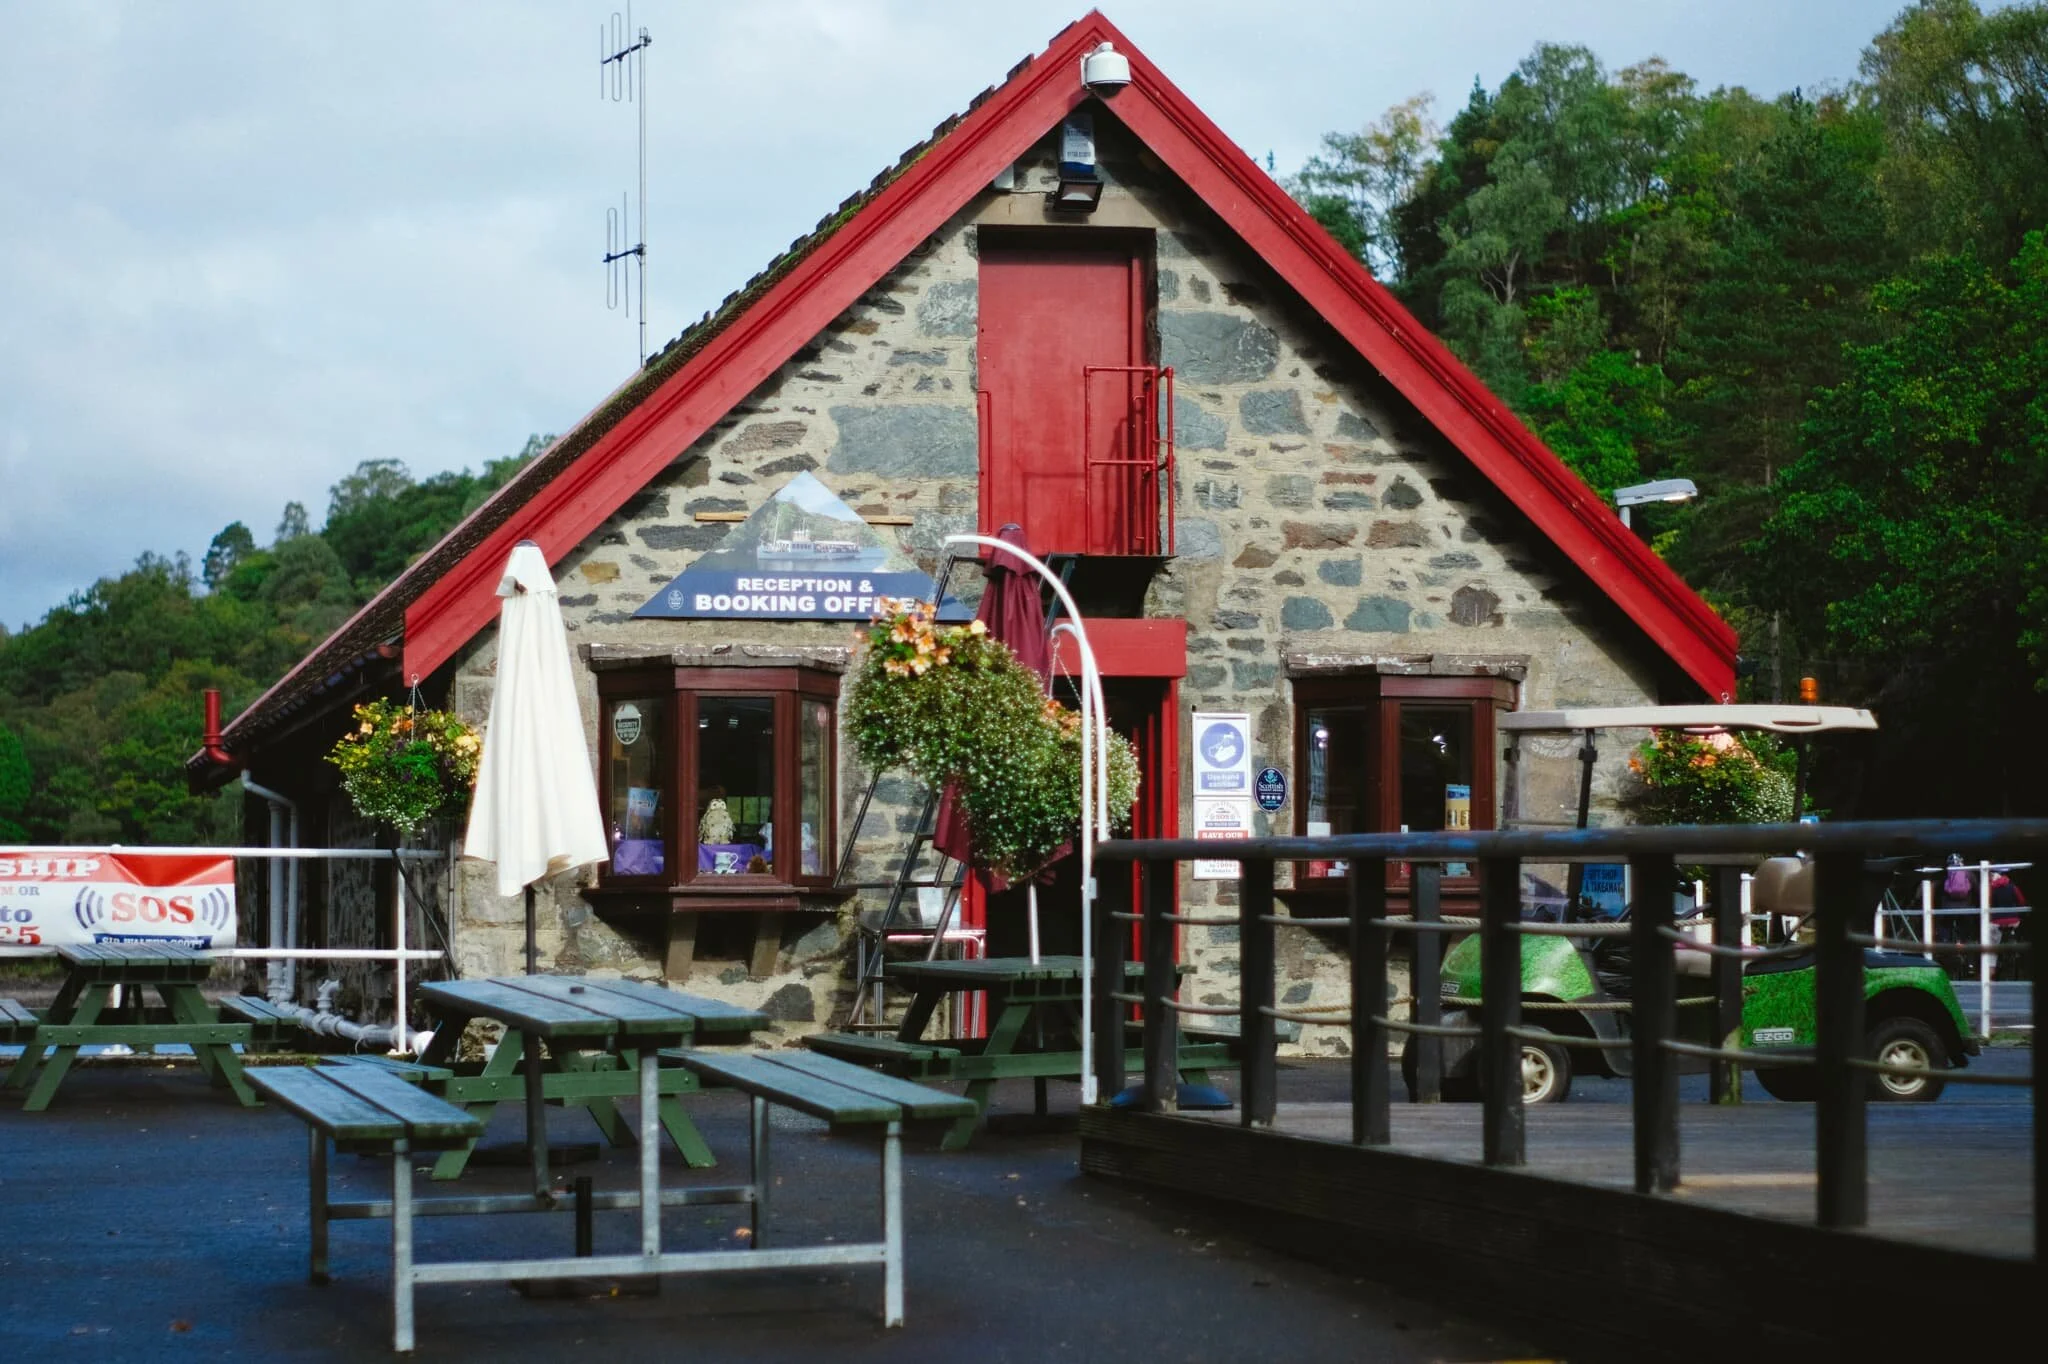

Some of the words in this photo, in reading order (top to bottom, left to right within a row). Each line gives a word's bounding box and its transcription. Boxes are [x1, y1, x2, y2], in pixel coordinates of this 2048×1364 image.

[736, 578, 852, 593] RECEPTION
[858, 579, 874, 593] &
[695, 594, 817, 612] BOOKING
[824, 595, 916, 613] OFFIE
[1202, 831, 1224, 839] SAVE
[1225, 831, 1244, 839] OUR
[0, 858, 101, 877] SHIP
[18, 886, 41, 896] OR
[0, 905, 33, 923] to
[111, 891, 196, 924] SOS
